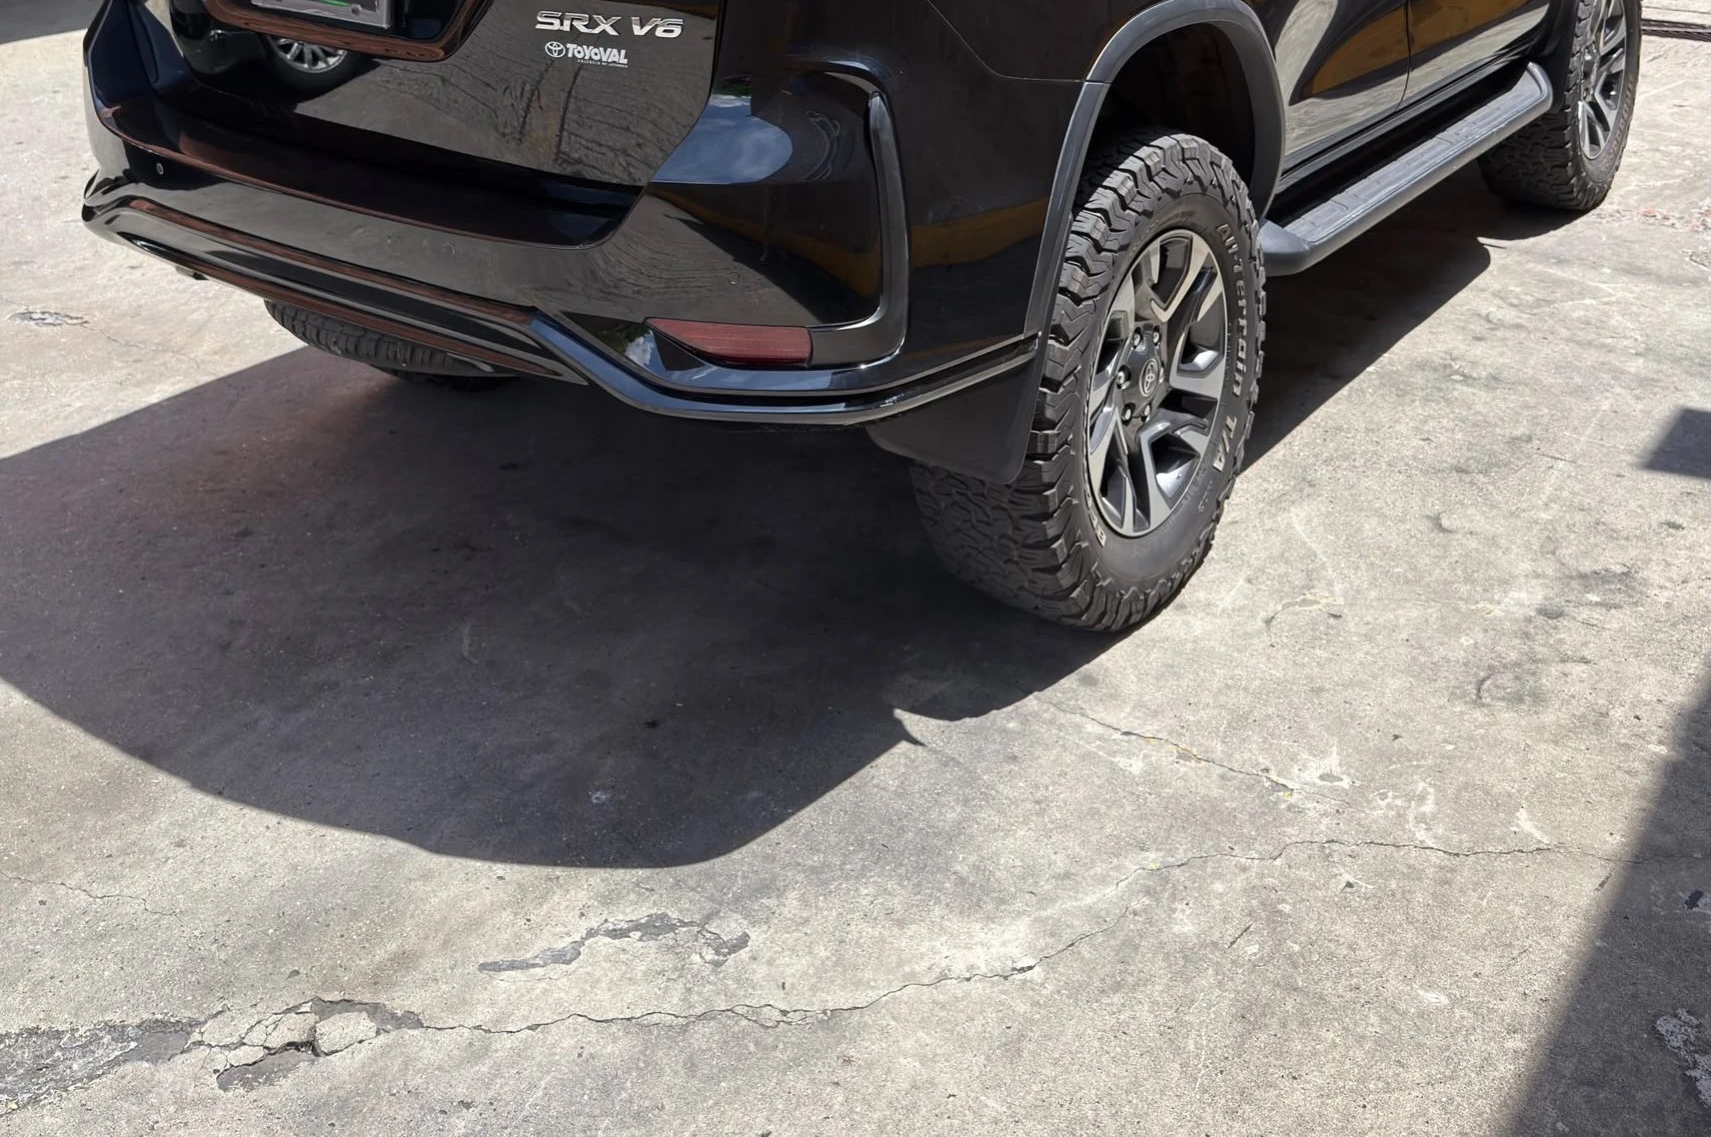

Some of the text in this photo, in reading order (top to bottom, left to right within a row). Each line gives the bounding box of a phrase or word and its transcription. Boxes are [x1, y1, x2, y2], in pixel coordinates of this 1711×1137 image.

[535, 11, 684, 38] SRX V6
[566, 43, 629, 64] TOYOVAL
